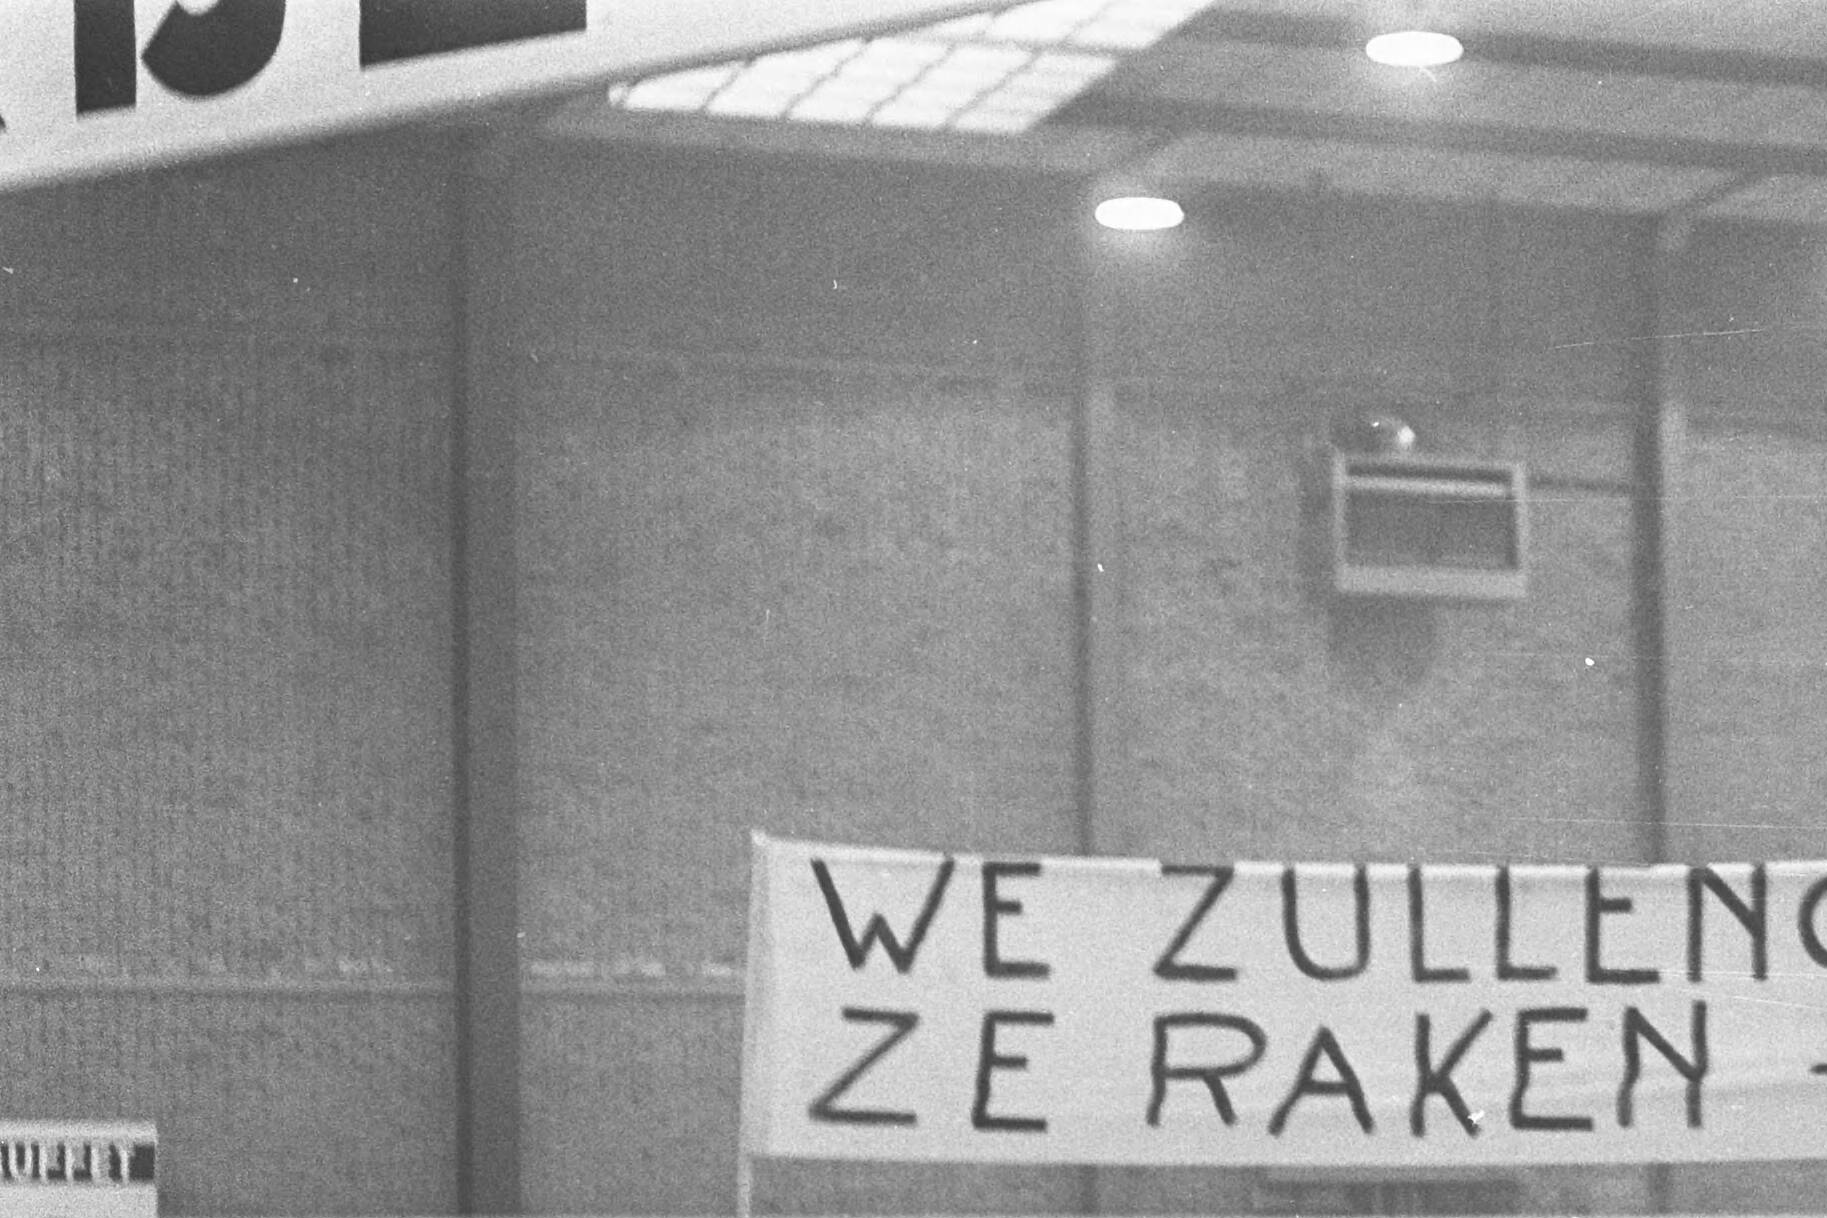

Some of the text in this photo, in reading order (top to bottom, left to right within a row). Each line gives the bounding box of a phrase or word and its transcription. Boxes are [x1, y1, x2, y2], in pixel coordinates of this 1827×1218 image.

[811, 858, 1769, 984] WE ZULLEN
[809, 1000, 1709, 1138] ZE RAKEN
[0, 1142, 138, 1184] UFFET
